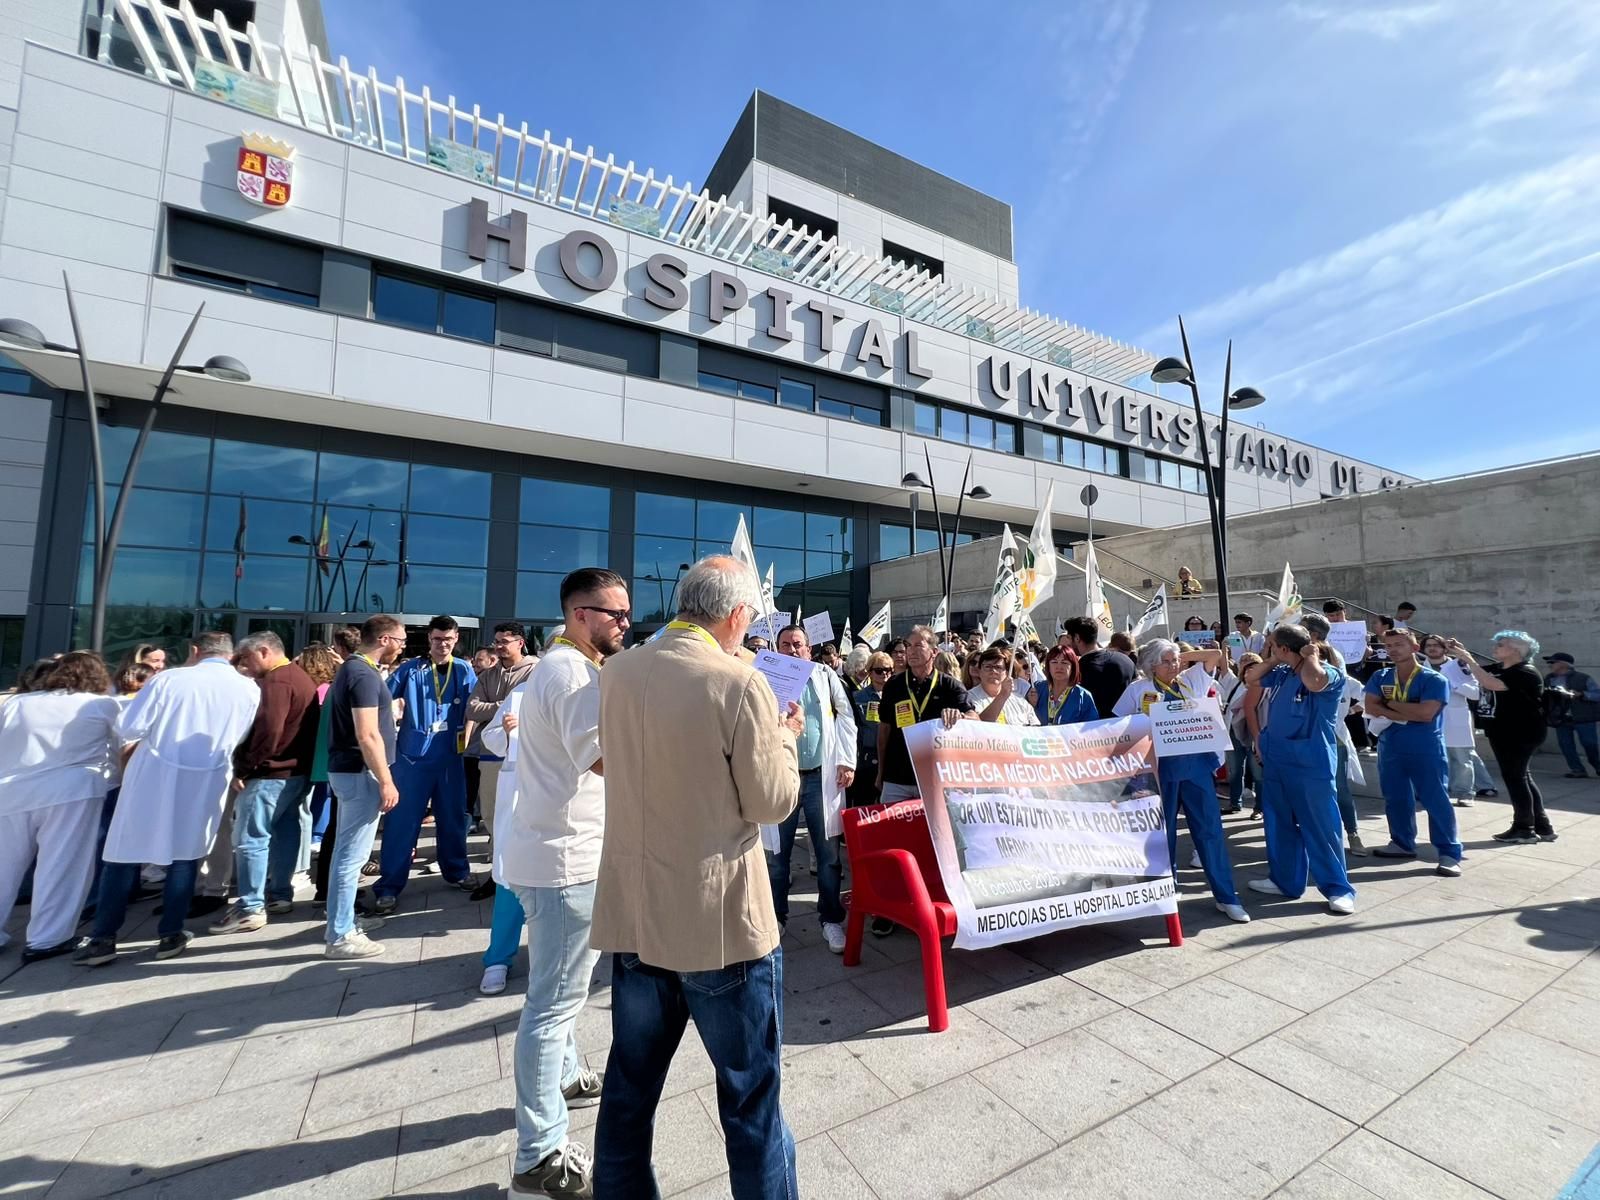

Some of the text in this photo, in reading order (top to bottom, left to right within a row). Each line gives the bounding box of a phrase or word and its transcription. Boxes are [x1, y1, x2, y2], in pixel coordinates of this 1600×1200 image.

[467, 197, 933, 380] HOSPITAL
[1333, 460, 1365, 493] DE
[1155, 716, 1202, 727] REGULACIÓN
[1174, 724, 1214, 734] GUARDIAS
[934, 735, 983, 751] Sindicato
[986, 738, 1019, 752] Médico
[1070, 733, 1131, 751] Salamanca
[1163, 733, 1214, 744] LOCALIZADAS
[936, 751, 1152, 783] HUELGA MÉDICA NACIONAL
[858, 807, 880, 825] No
[960, 801, 1166, 833] OR UN ESTATUTO DE LA PROFESIÓN
[990, 878, 1033, 896] octubre
[977, 906, 1047, 933] MEDICO/AS
[1049, 902, 1073, 920] DEL
[1074, 893, 1125, 916] HOSPITAL
[1126, 890, 1140, 906] DE
